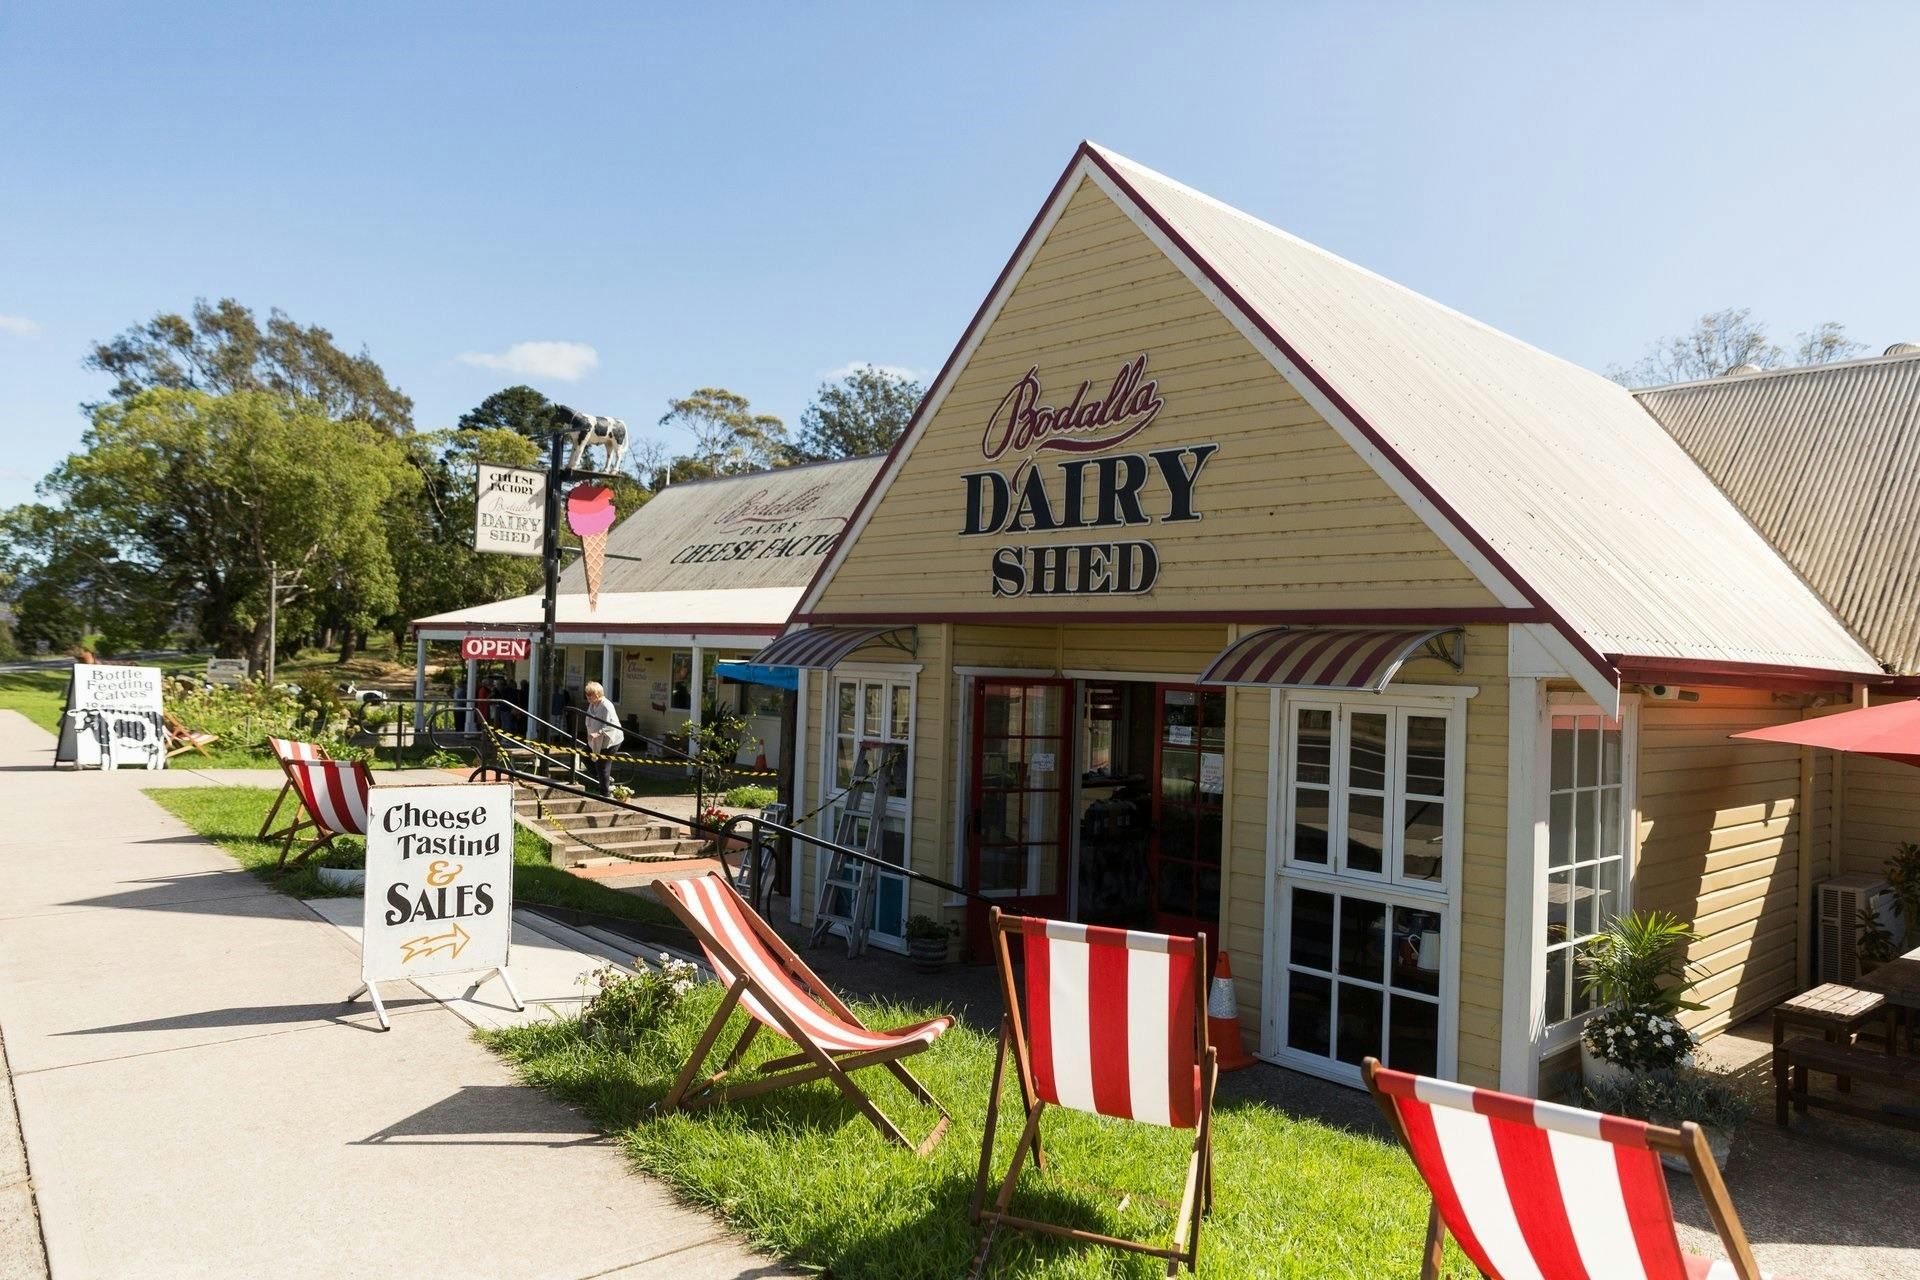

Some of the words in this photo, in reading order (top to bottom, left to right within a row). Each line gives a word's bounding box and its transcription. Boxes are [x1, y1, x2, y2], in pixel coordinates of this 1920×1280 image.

[982, 353, 1164, 461] Bodalla
[489, 473, 535, 485] CHEESE
[490, 483, 534, 495] FACTORY
[958, 443, 1220, 537] DAIRY
[480, 512, 542, 532] DAIRY
[739, 521, 803, 536] DAIRY
[489, 529, 531, 544] SHED
[670, 539, 765, 564] CHEESE
[991, 539, 1160, 598] SHED
[466, 639, 527, 656] OPEN
[92, 669, 142, 680] Bottle
[87, 680, 153, 691] Feeding
[93, 690, 147, 701] Calves
[383, 802, 487, 833] Cheese
[397, 832, 500, 860] Tasting
[426, 860, 463, 887] &
[385, 882, 494, 927] SALES
